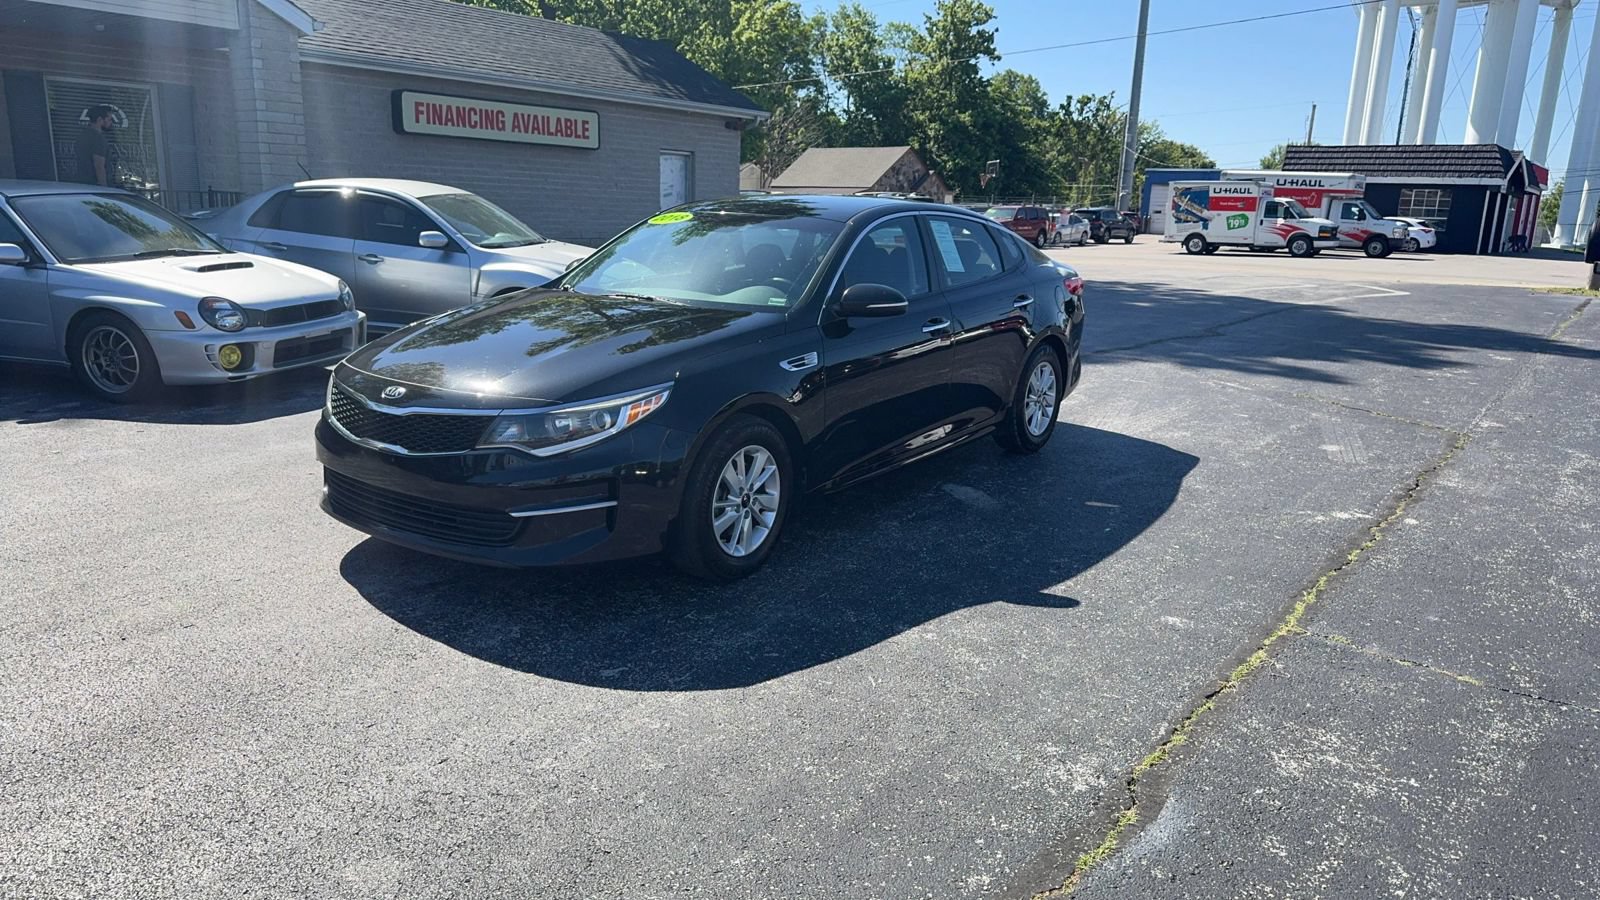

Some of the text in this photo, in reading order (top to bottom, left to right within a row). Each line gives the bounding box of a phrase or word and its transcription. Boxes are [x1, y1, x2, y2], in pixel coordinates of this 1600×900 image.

[414, 101, 590, 140] FINANCING AVAILABLE
[1276, 178, 1326, 188] U-HAUL
[1213, 187, 1253, 195] U-HAUL
